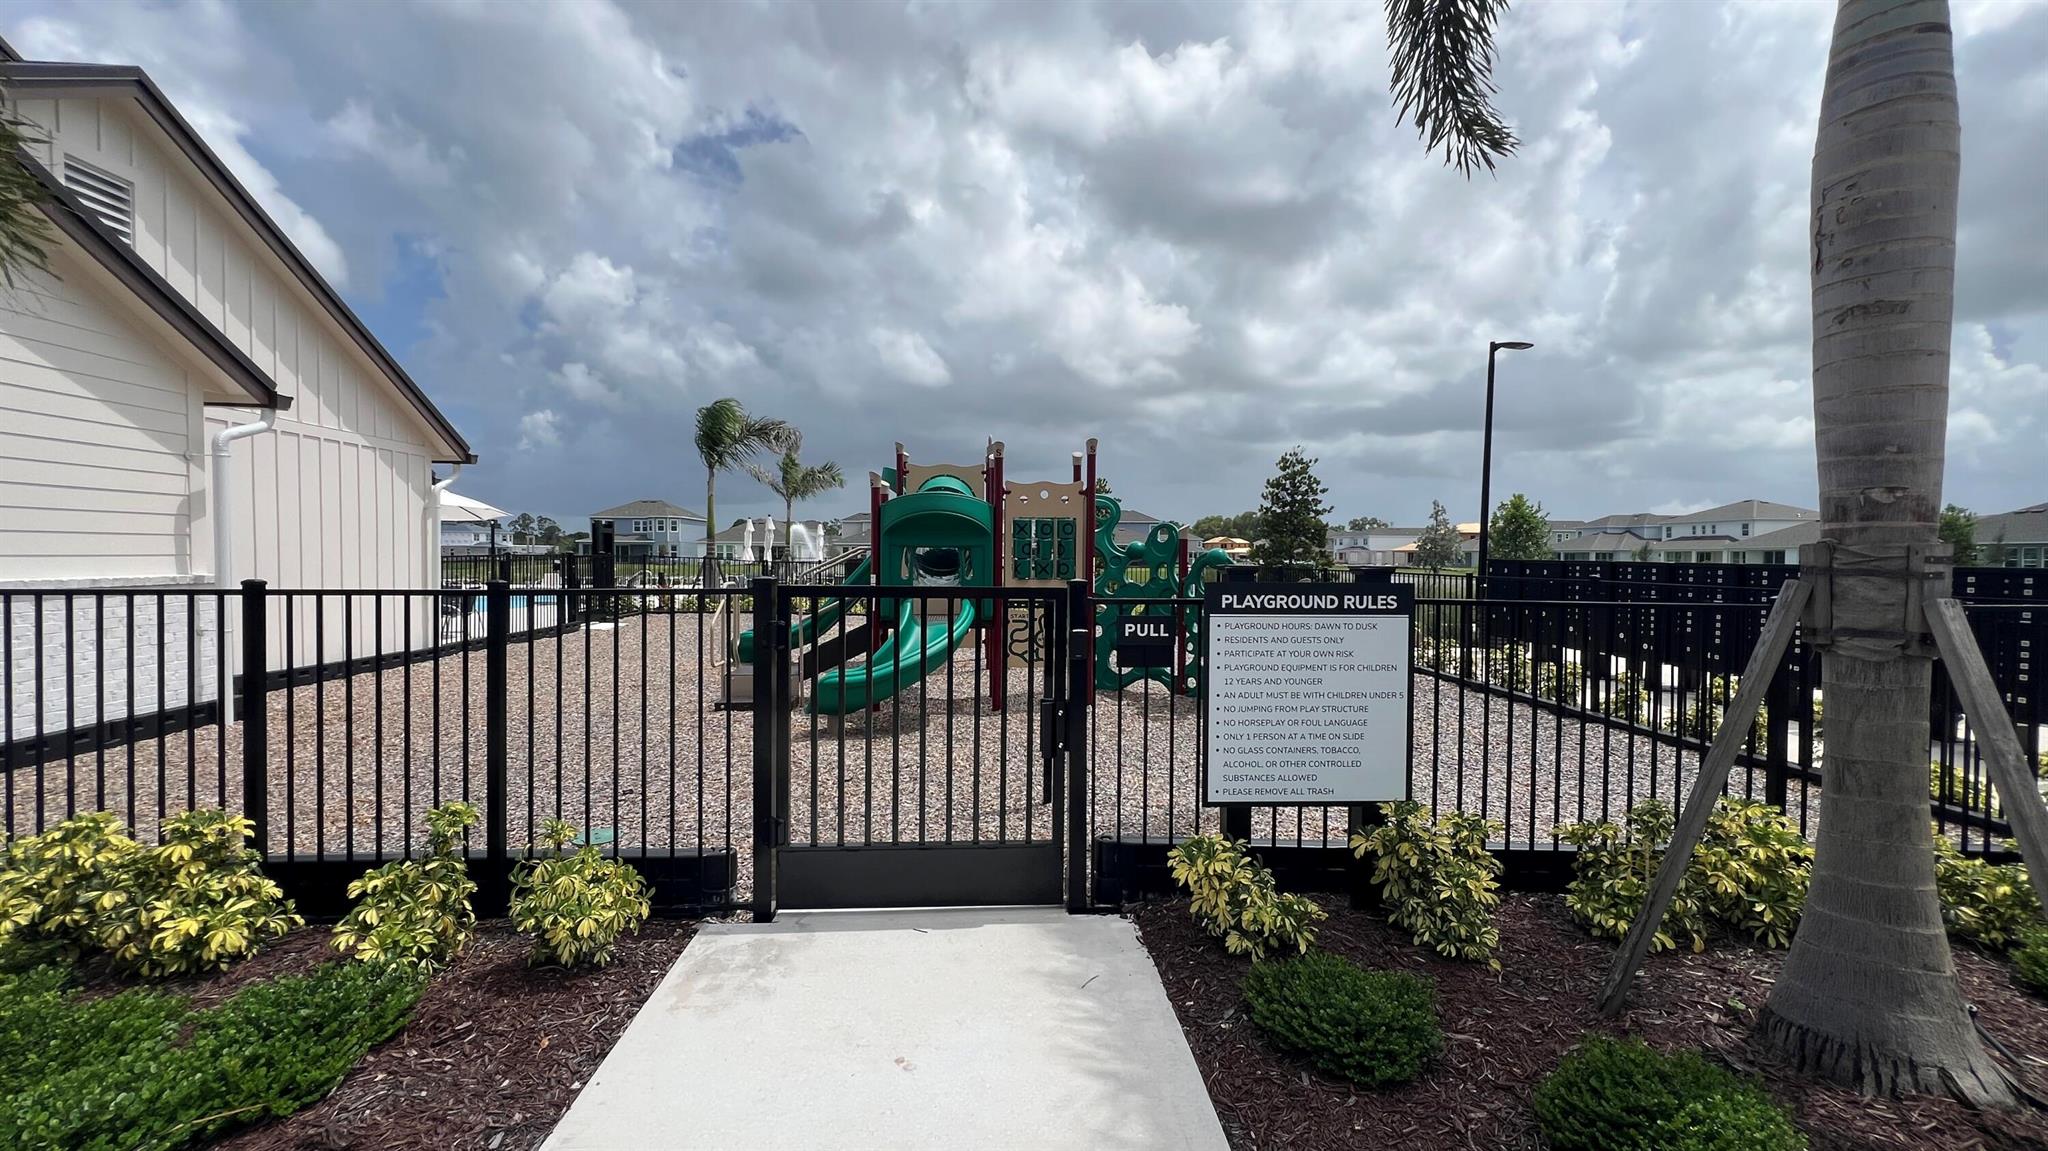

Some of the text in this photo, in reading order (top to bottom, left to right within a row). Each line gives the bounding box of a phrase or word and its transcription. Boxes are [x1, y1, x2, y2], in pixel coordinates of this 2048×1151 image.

[1221, 594, 1398, 609] PLAYGROUND RULES
[1124, 623, 1169, 637] PULL
[1224, 622, 1378, 631] PLAYGROUND HOURS: DAWN TO DUSK
[1224, 636, 1345, 644] RESIDENTS AND GUESTS ONLY
[1224, 650, 1354, 658] PARTICIPATE AT YOUR OWN RISK
[1224, 664, 1397, 673] PLAYGROUND EQUIPMENT IS FOR CHILDREN
[1224, 677, 1323, 686] 12 YEARS AND YOUNGER
[1223, 691, 1404, 699] AN ADULT MUST BE WITH CHILDREN UNDER 5
[1223, 705, 1369, 713] NO JUMPING FROM PLAY STRUCTURE
[1223, 719, 1368, 727] NO HORSEPLAY OR FOUL LANGUAGE
[1223, 733, 1365, 741] ONLY 1 PERSON AT A TIME ON SLIDE
[1223, 746, 1361, 755] NO GLASS CONTAINERS, TOBACCO,
[1223, 760, 1362, 769] ALCOHOL, OR OTHER CONTROLLED
[1223, 774, 1318, 782] SUBSTANCES ALLOWED
[1223, 788, 1334, 796] PLEASE REMOVE ALL TRASH
